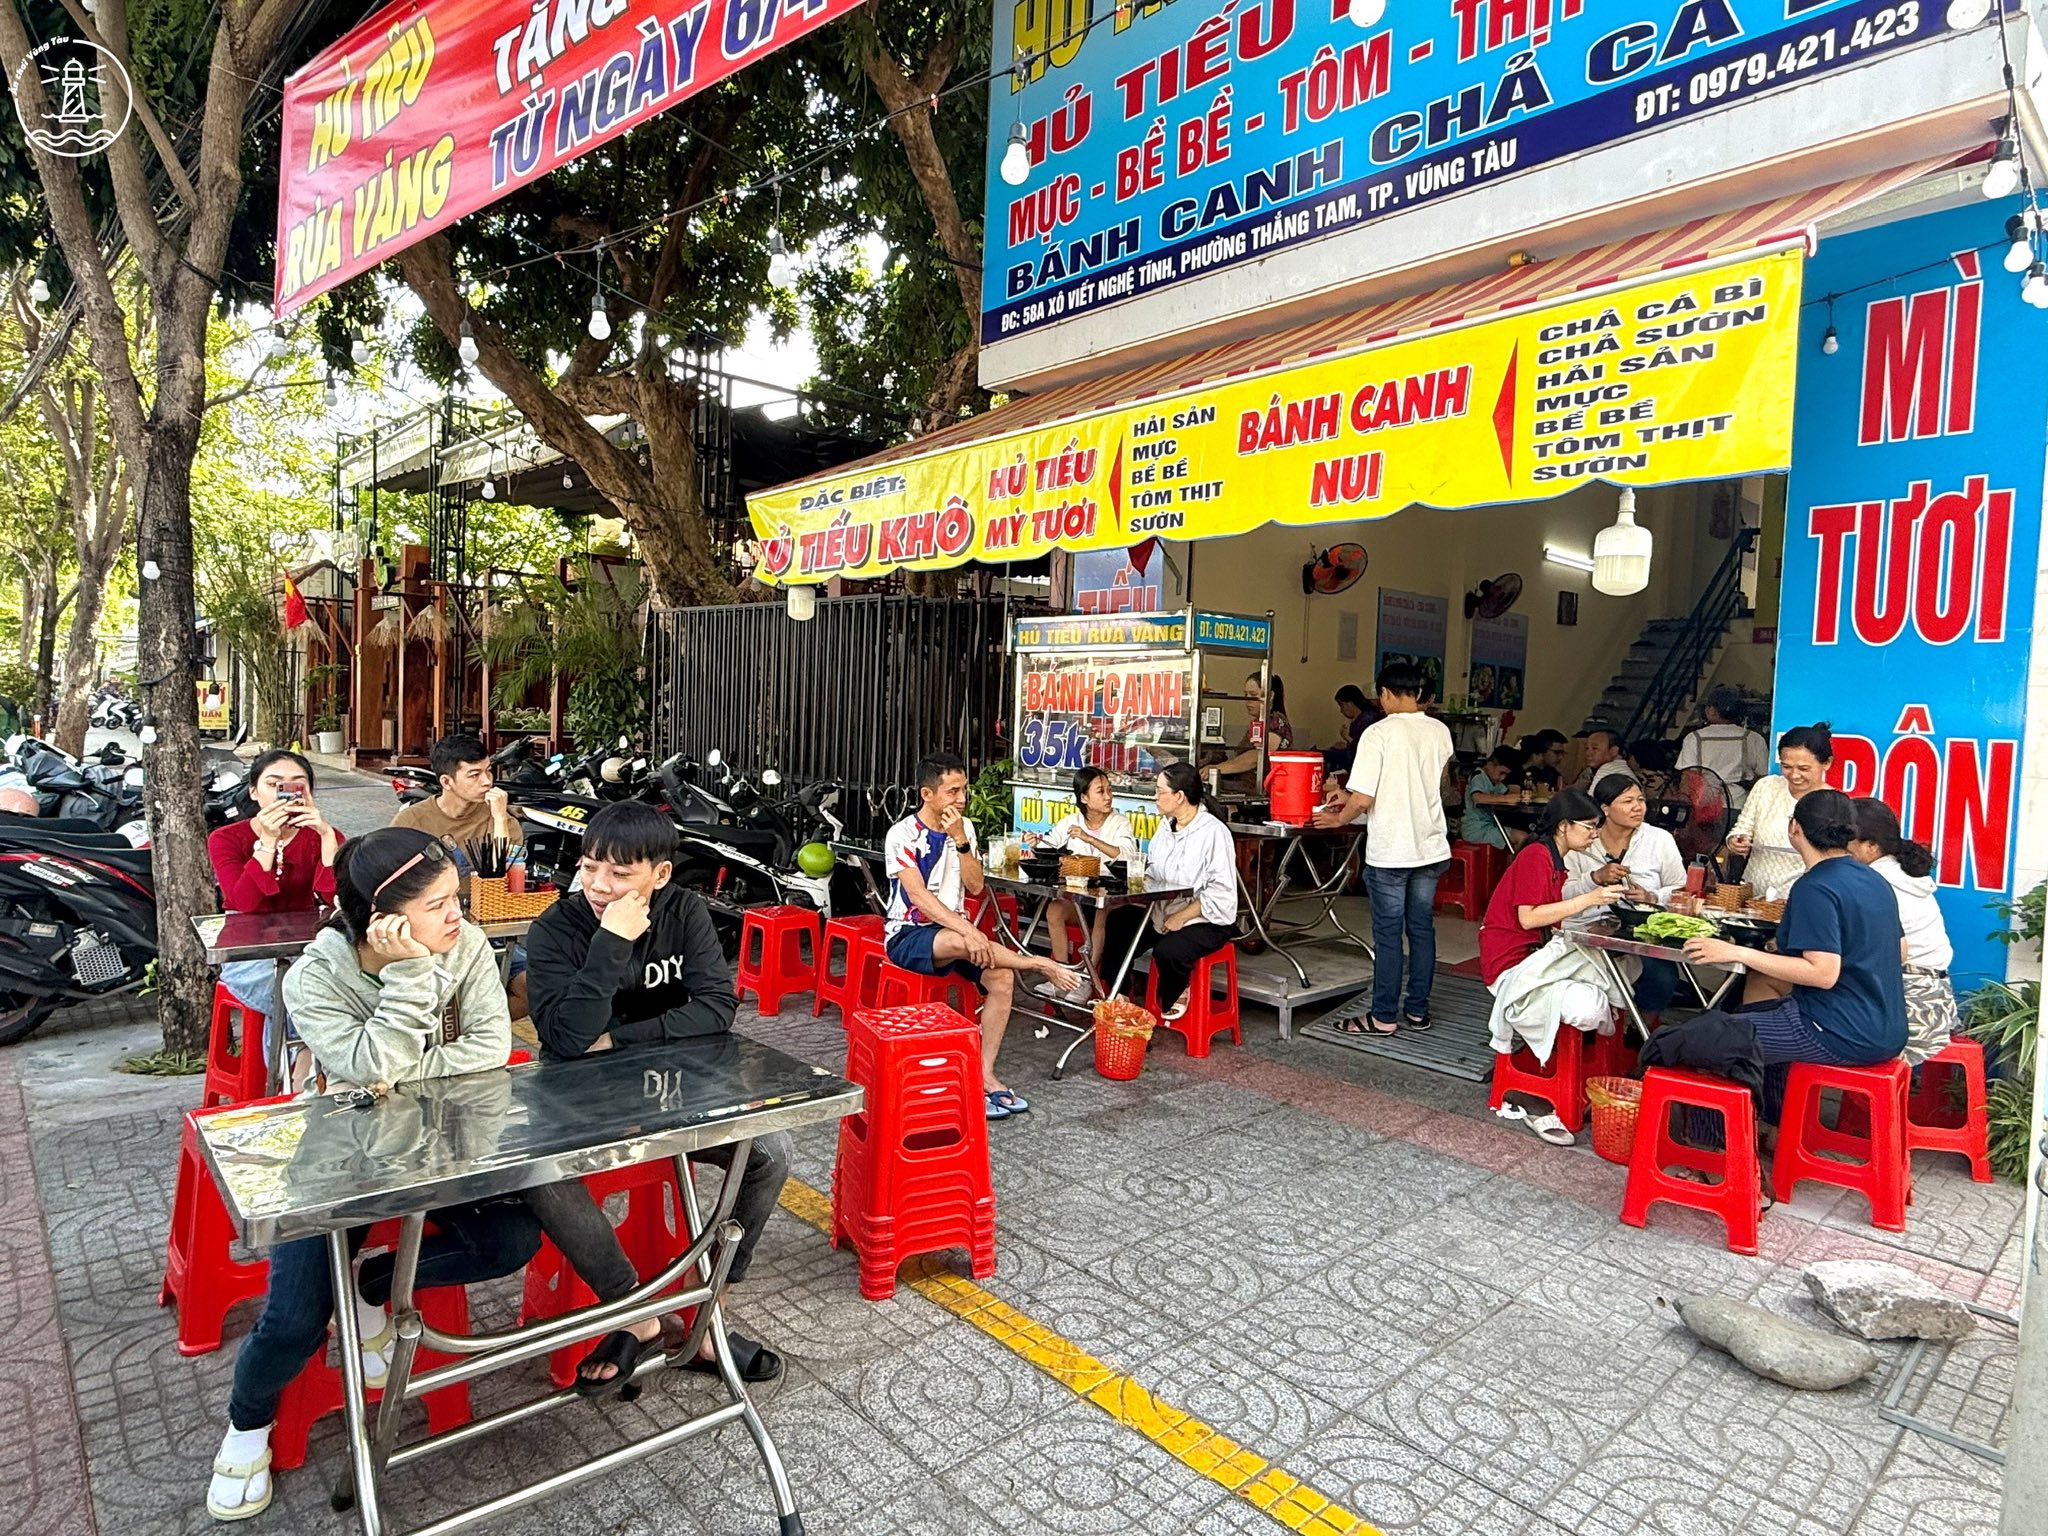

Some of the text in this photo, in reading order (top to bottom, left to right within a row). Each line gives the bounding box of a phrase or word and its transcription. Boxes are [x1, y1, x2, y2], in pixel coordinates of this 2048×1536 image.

[1025, 0, 1297, 168] HỦ TIẾU
[1635, 1, 1919, 124] ĐT: 0979.421.423
[306, 54, 359, 175] HỦ
[488, 89, 556, 191] TỪ
[554, 16, 712, 158] NGÀY
[1008, 173, 1081, 248] MỰC
[1116, 115, 1166, 204] BỀ
[1177, 83, 1234, 180] BỀ
[1278, 28, 1393, 136] TÔM
[1006, 216, 1141, 300] BÁNH
[1159, 137, 1344, 242] CANH
[1369, 50, 1554, 165] CHẢ
[1001, 139, 1518, 333] ĐC: 58A XÔ VIẾT NGHỆ TĨNH, PHƯỜNG THẮNG TAM, TP. VŨNG TÀU
[1539, 278, 1762, 342] CHẢ CÁ BÌ
[1539, 305, 1765, 365] CHẢ SƯỜN
[1537, 343, 1714, 390] HẢI SẢN
[1858, 248, 1984, 446] MÌ
[1238, 365, 1472, 456] BÁNH CANH
[1536, 384, 1628, 408] MỰC
[1133, 406, 1215, 437] HẢI SẢN
[1533, 414, 1733, 458] TÔM THỊT
[988, 438, 1098, 500] HỦ TIẾU
[1132, 458, 1187, 485] BỀ BỀ
[1133, 440, 1176, 461] MỰC
[1533, 454, 1647, 480] SƯỜN
[800, 475, 906, 511] ĐẶC BIỆT:
[1131, 481, 1224, 508] TÔM THỊT
[1310, 452, 1383, 506] NUI
[799, 509, 873, 575] TIẾU
[877, 495, 974, 567] KHÔ
[1032, 497, 1098, 543] TƯƠI
[1130, 511, 1183, 532] SƯỜN
[1809, 474, 2016, 646] TƯƠI
[1018, 625, 1041, 645] HỦ
[1214, 622, 1266, 643] 0979.421.423
[1025, 664, 1183, 718] BÁNH CANH
[1021, 719, 1088, 769] 35k
[557, 805, 588, 820] 46
[1021, 790, 1043, 822] HỦ
[1046, 794, 1078, 825] TIẾ
[644, 954, 684, 989] DIY
